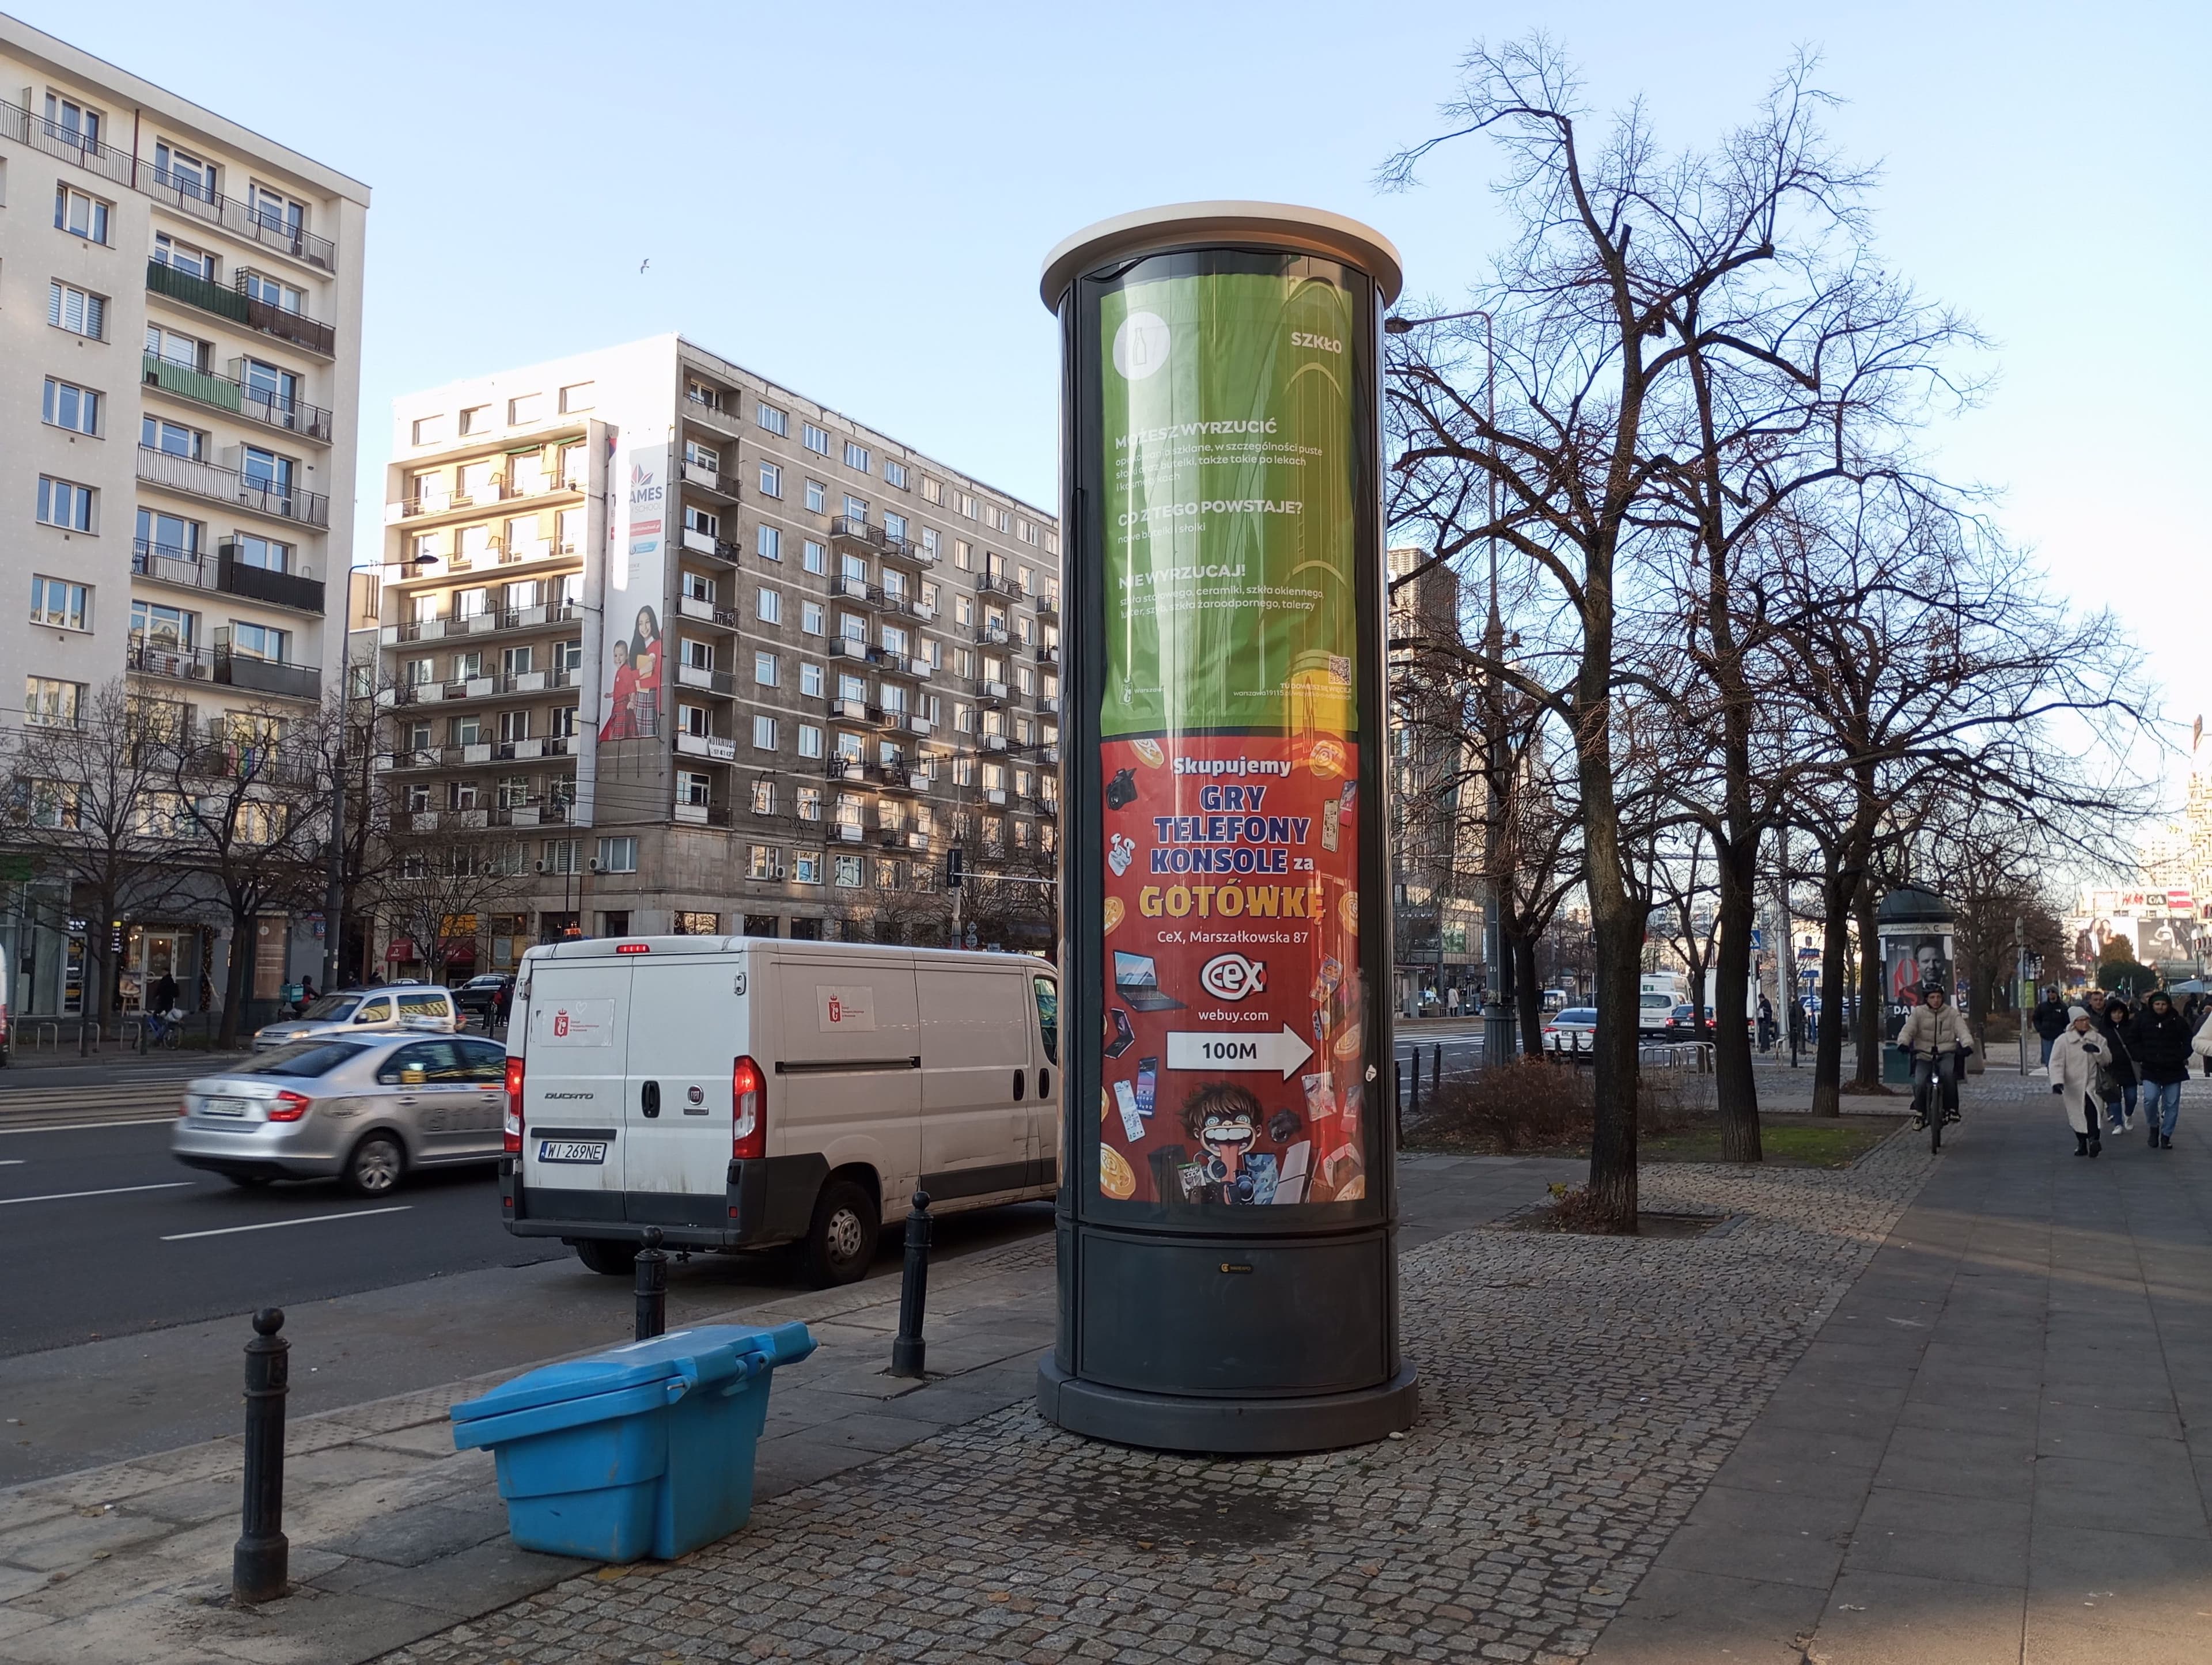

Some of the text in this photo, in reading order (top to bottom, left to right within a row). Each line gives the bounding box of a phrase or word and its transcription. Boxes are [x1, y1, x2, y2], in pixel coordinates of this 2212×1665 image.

[1291, 332, 1342, 354] SZKŁO
[1115, 417, 1277, 449] MOŻESZ WYRZUCIĆ
[1172, 444, 1213, 455] szklane,
[1226, 442, 1297, 452] szczególności
[1299, 446, 1323, 456] puste
[1116, 466, 1138, 479] słoki
[1198, 455, 1228, 464] także
[1230, 454, 1257, 463] takie
[1259, 456, 1272, 465] po
[1274, 455, 1306, 466] lekach
[612, 486, 662, 507] TAMES
[1118, 500, 1302, 526] CO Z TEGO POWSTAJE?
[1119, 564, 1245, 589] NIE WYRZUCAJ!
[1196, 585, 1244, 596] ceramiki,
[1246, 585, 1273, 594] szkła
[1274, 586, 1324, 599] okiennego,
[1121, 609, 1145, 619] luter,
[1169, 600, 1195, 611] szkła
[1197, 599, 1281, 609] żaroodpornego,
[1282, 600, 1315, 611] talerzy
[1173, 756, 1291, 777] Skupujemy
[1199, 785, 1267, 813] GRY
[1153, 816, 1311, 844] TELEFONY
[1150, 848, 1314, 874] KONSOLE za
[1157, 930, 1308, 945] CeX, Marszałkowska 87
[1198, 1010, 1269, 1022] webuy.com
[1893, 1006, 1916, 1015] DA
[1202, 1042, 1257, 1059] 100M
[548, 1144, 602, 1159] WI 269NE
